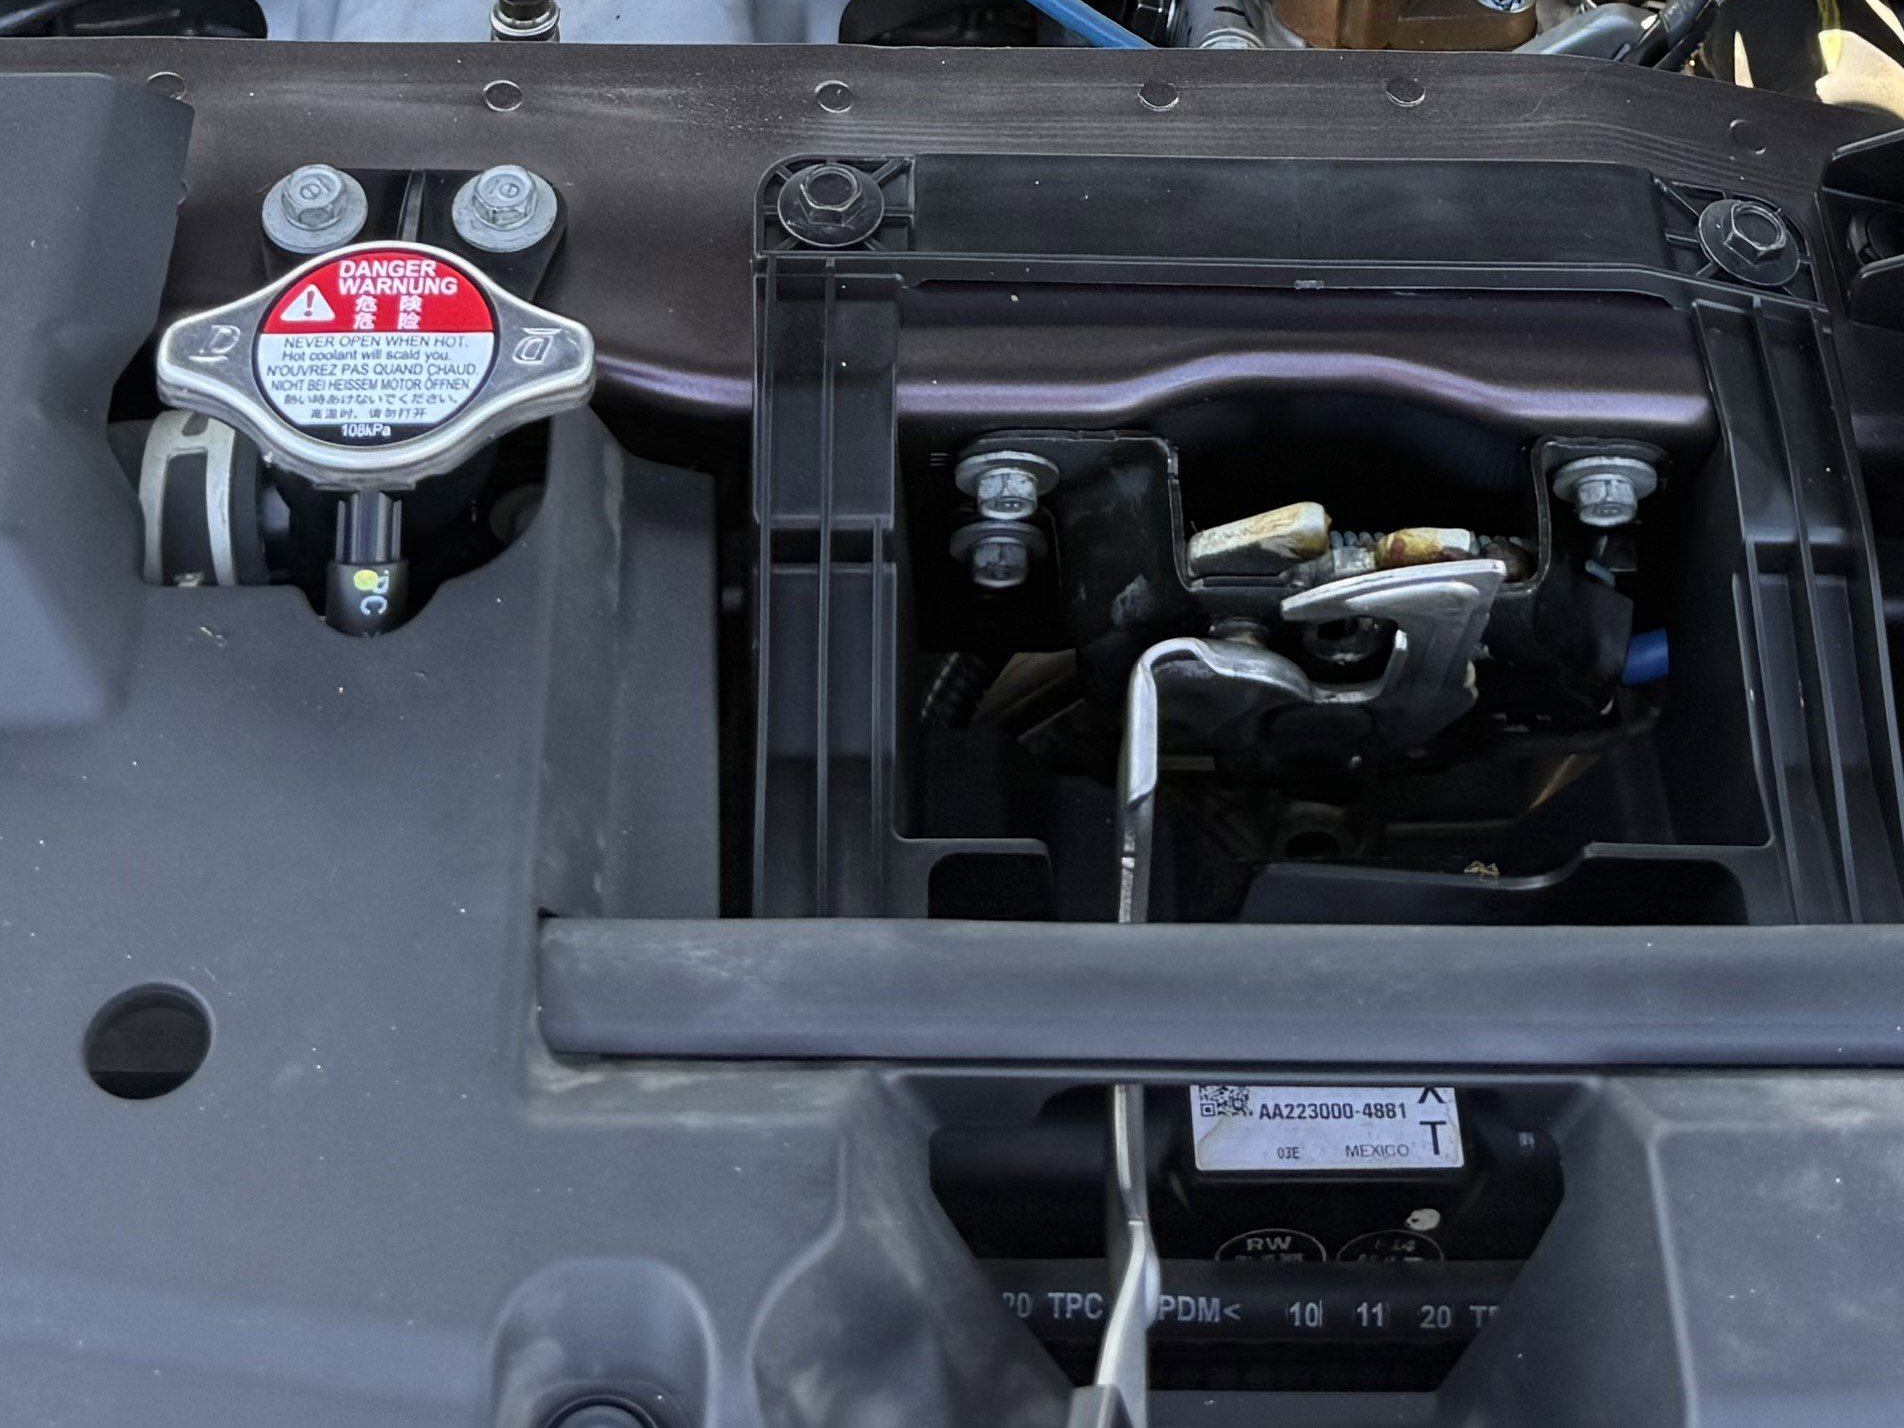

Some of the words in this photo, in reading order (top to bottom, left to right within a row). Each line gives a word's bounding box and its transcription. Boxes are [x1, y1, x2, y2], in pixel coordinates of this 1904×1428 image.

[339, 260, 437, 277] DANGER
[339, 278, 458, 294] WARNUNG
[284, 336, 335, 348] NEVER
[339, 335, 381, 347] OPEN
[385, 335, 430, 347] WHEN
[282, 350, 305, 362] Hot
[309, 349, 357, 361] coolant
[361, 349, 383, 360] will
[386, 349, 420, 360] scald
[267, 364, 338, 376] N'OUVREZ
[341, 363, 369, 375] PAS
[373, 363, 423, 375] QUAND
[271, 379, 305, 391] NICHT
[307, 379, 326, 391] BEI
[328, 378, 377, 391] HEISSEM
[381, 378, 422, 390] MOTOR
[341, 424, 392, 437] 108kPa
[1259, 1102, 1407, 1120] AA223000-4881
[1419, 1120, 1447, 1155] T
[1346, 1144, 1409, 1158] MEXICO
[1048, 1292, 1103, 1319] TPC
[1419, 1305, 1452, 1328] 20
